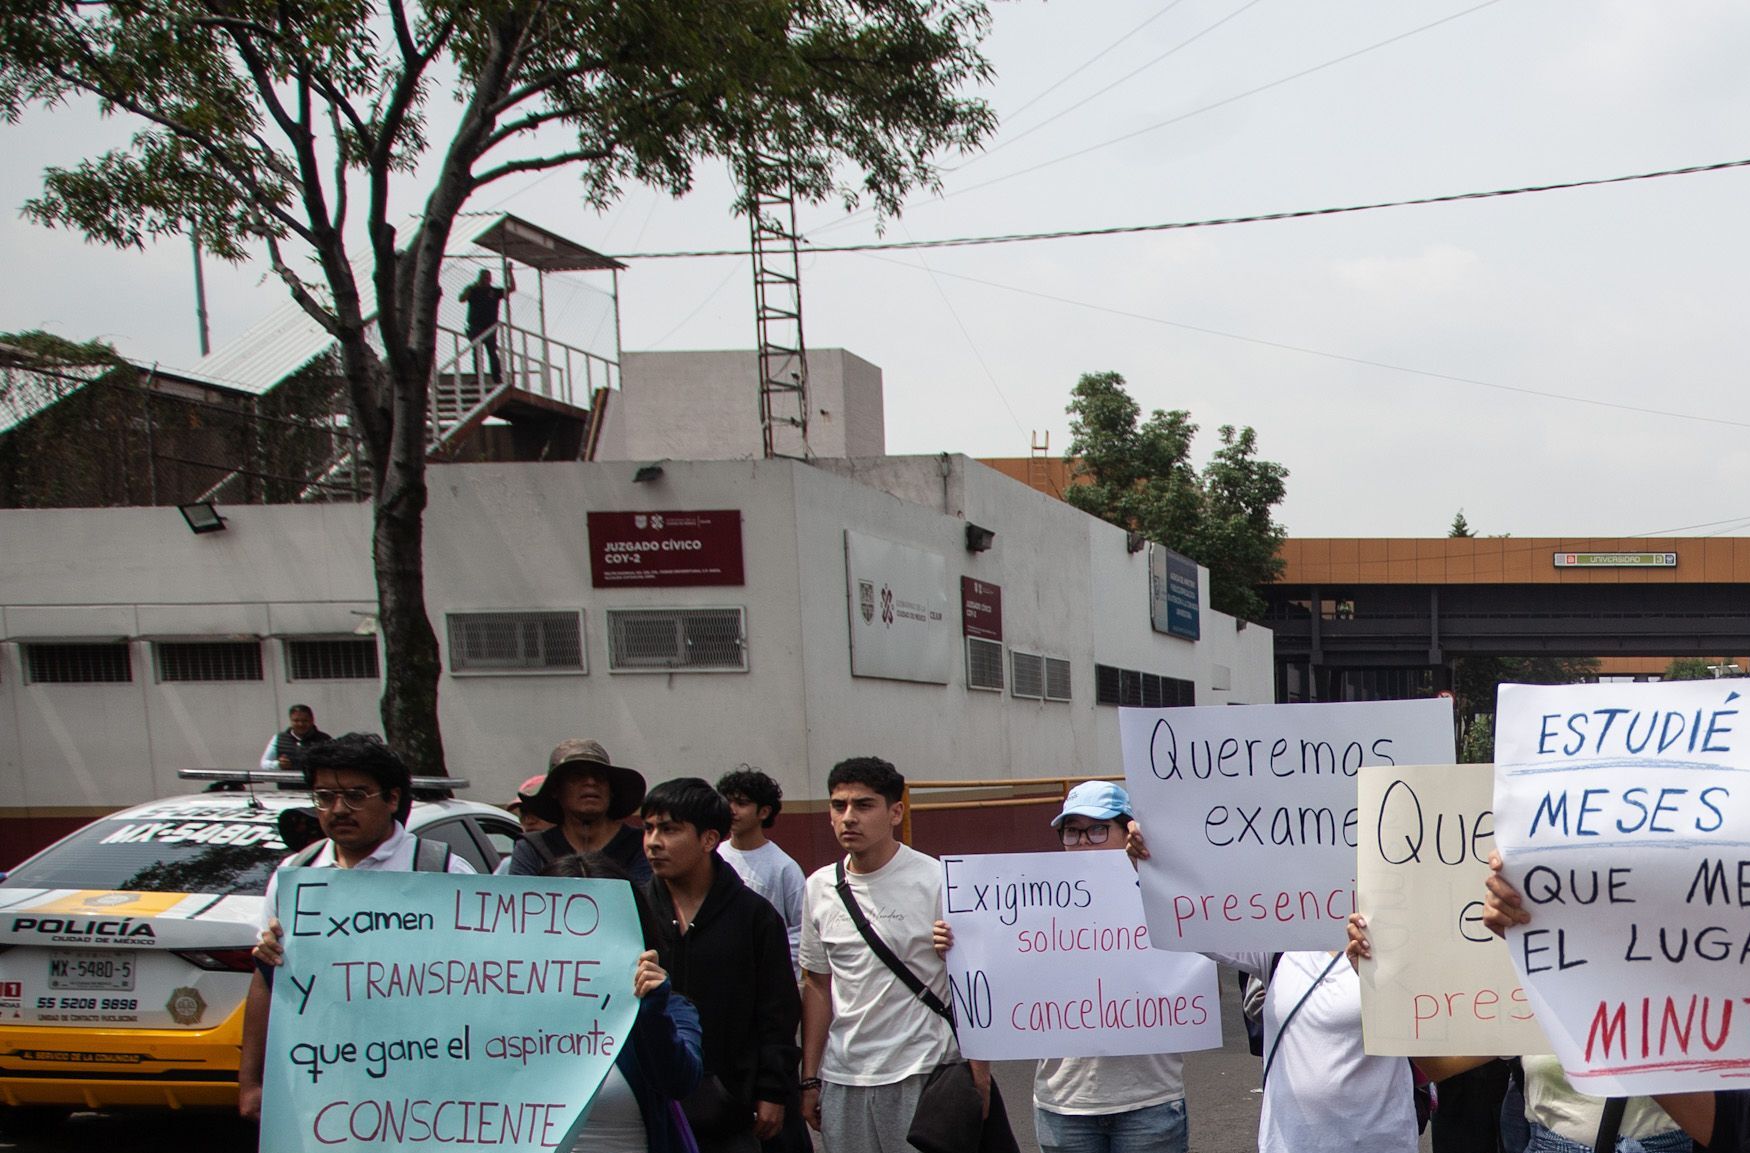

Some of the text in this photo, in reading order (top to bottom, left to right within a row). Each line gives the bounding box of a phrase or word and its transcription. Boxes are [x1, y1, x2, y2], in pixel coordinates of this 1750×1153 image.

[604, 538, 702, 552] JUZGADO CÍVICO
[604, 554, 641, 564] COY-2
[1537, 691, 1740, 756] ESTUDIÉ
[1149, 718, 1396, 781] Queremos
[1204, 805, 1359, 848] exame
[1377, 780, 1495, 866] Que
[1529, 786, 1731, 838] MESES
[292, 882, 599, 938] Examen LIMPIO
[944, 859, 1093, 926] Exigimos
[1173, 878, 1358, 938] presenci
[1523, 865, 1636, 906] QUE
[12, 917, 156, 938] POLICÍA
[51, 935, 156, 946] CIUDAD DE MÉXICO
[1017, 917, 1149, 953] solucione
[1523, 929, 1588, 975] EL
[37, 997, 138, 1010] 55 5208 9898
[332, 960, 611, 1011] TRANSPARENTE,
[949, 969, 1209, 1032] NO cancelaciones
[1414, 989, 1536, 1039] pres
[290, 1019, 615, 1084] que gane el aspirante
[313, 1098, 567, 1147] CONSCIENTE
